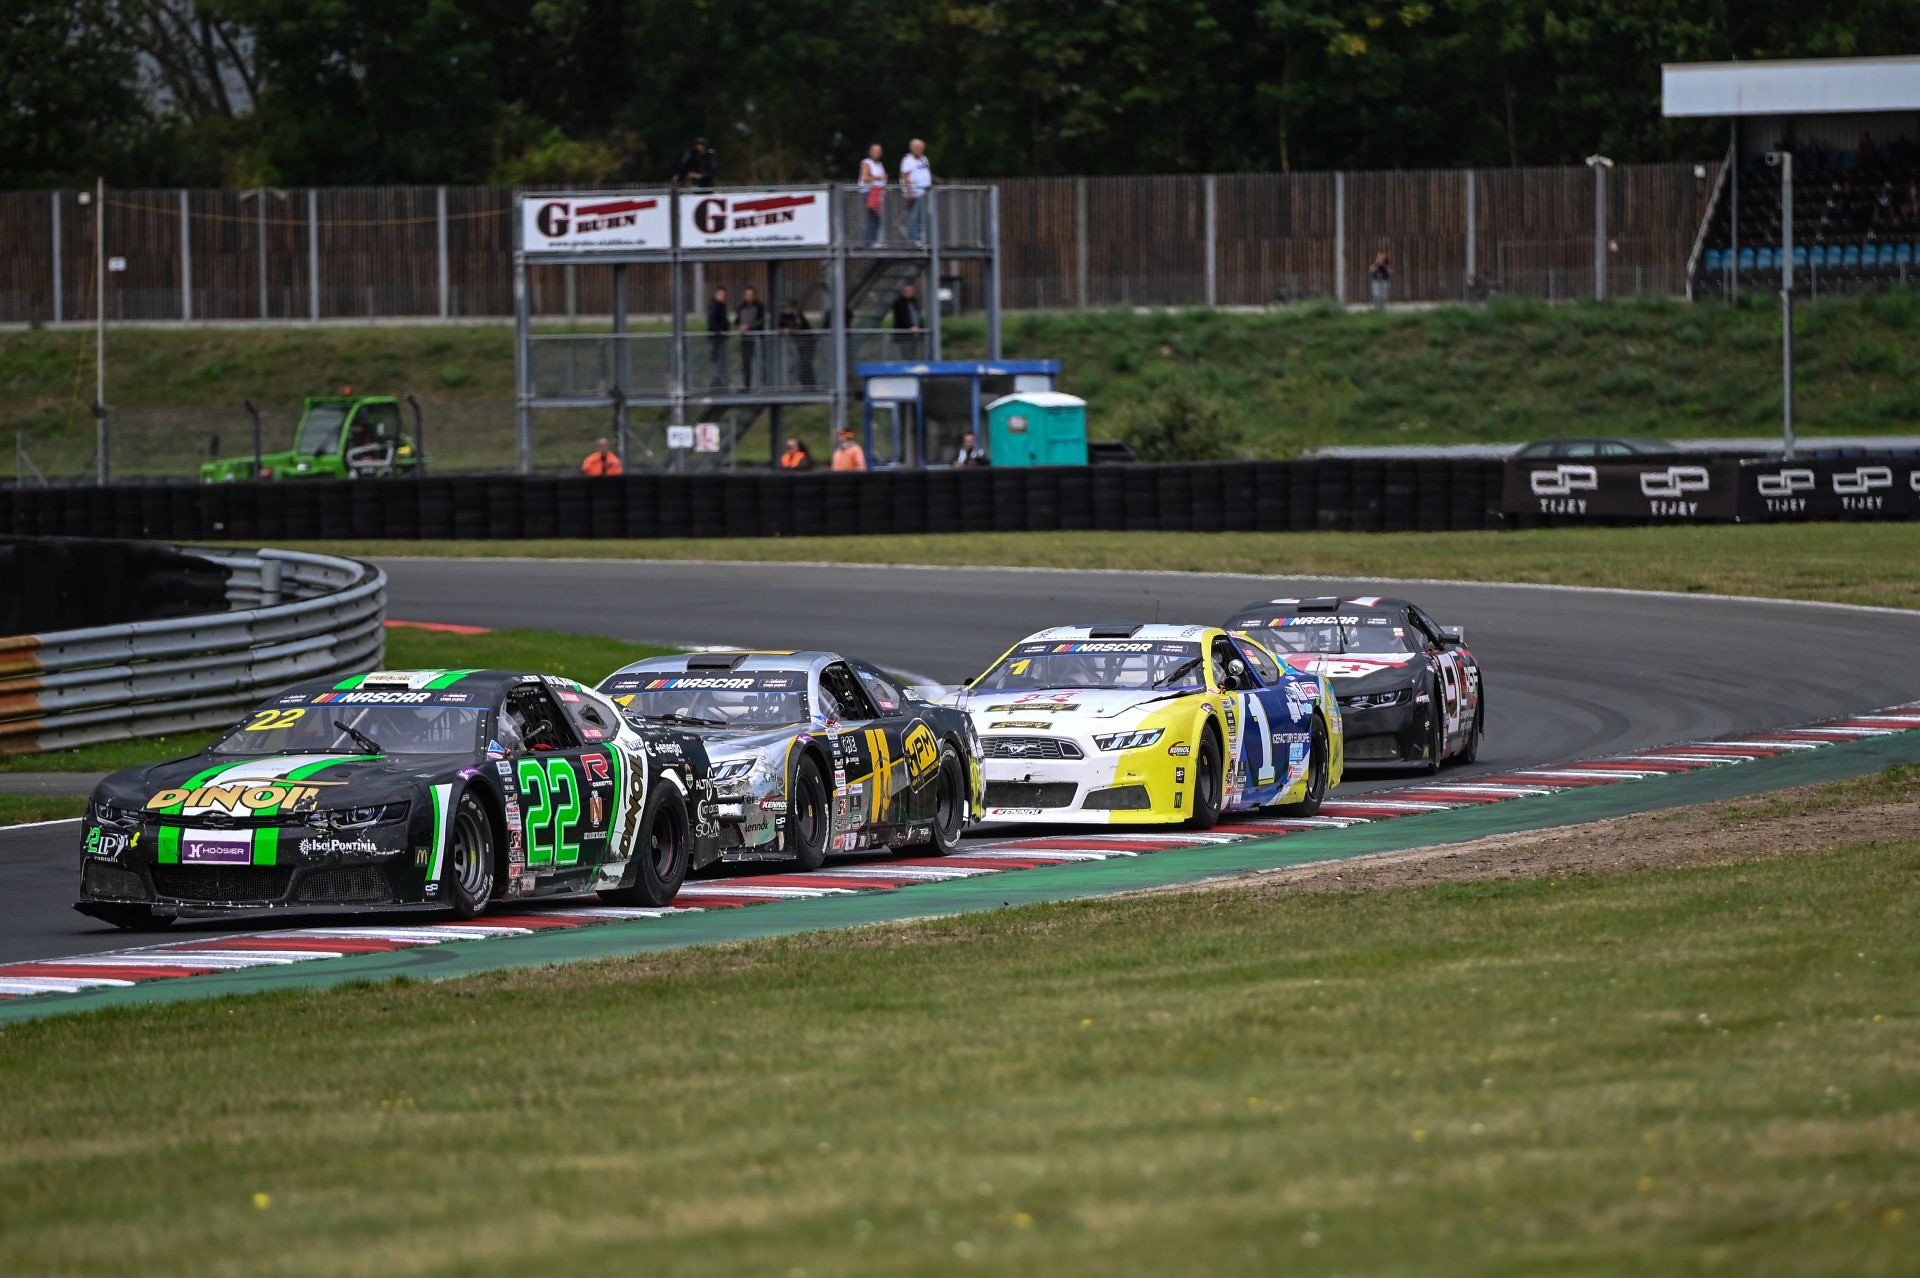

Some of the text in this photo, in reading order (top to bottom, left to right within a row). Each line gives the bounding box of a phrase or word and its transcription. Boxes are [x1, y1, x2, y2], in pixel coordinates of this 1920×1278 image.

[1650, 500, 1698, 516] TIJEY
[1290, 615, 1359, 625] NASCAR
[1076, 643, 1153, 653] NASCAR
[1009, 658, 1032, 675] 1
[671, 678, 755, 689] NASCAR
[338, 692, 431, 704] NASCAR
[245, 708, 306, 731] 22
[1248, 693, 1275, 785] 1
[517, 757, 581, 868] 22
[202, 845, 245, 855] HOOSIER
